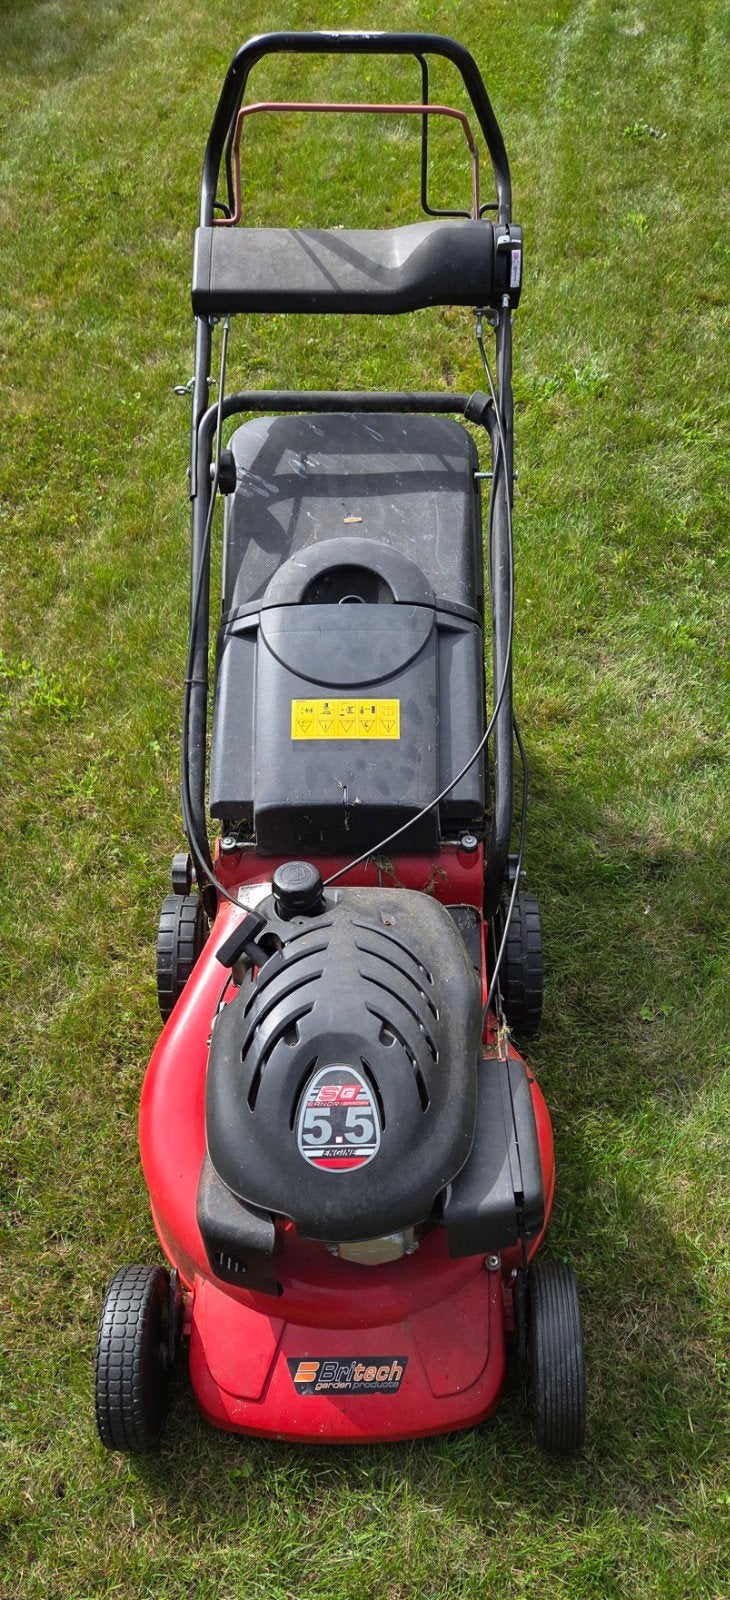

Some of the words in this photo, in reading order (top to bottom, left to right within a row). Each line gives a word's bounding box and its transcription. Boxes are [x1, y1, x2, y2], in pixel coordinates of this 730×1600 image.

[318, 1086, 357, 1101] SG
[302, 1107, 374, 1145] 5.5
[323, 1149, 358, 1157] ENGINE
[318, 1361, 403, 1382] Britech
[315, 1382, 352, 1391] garden
[352, 1381, 399, 1389] products
